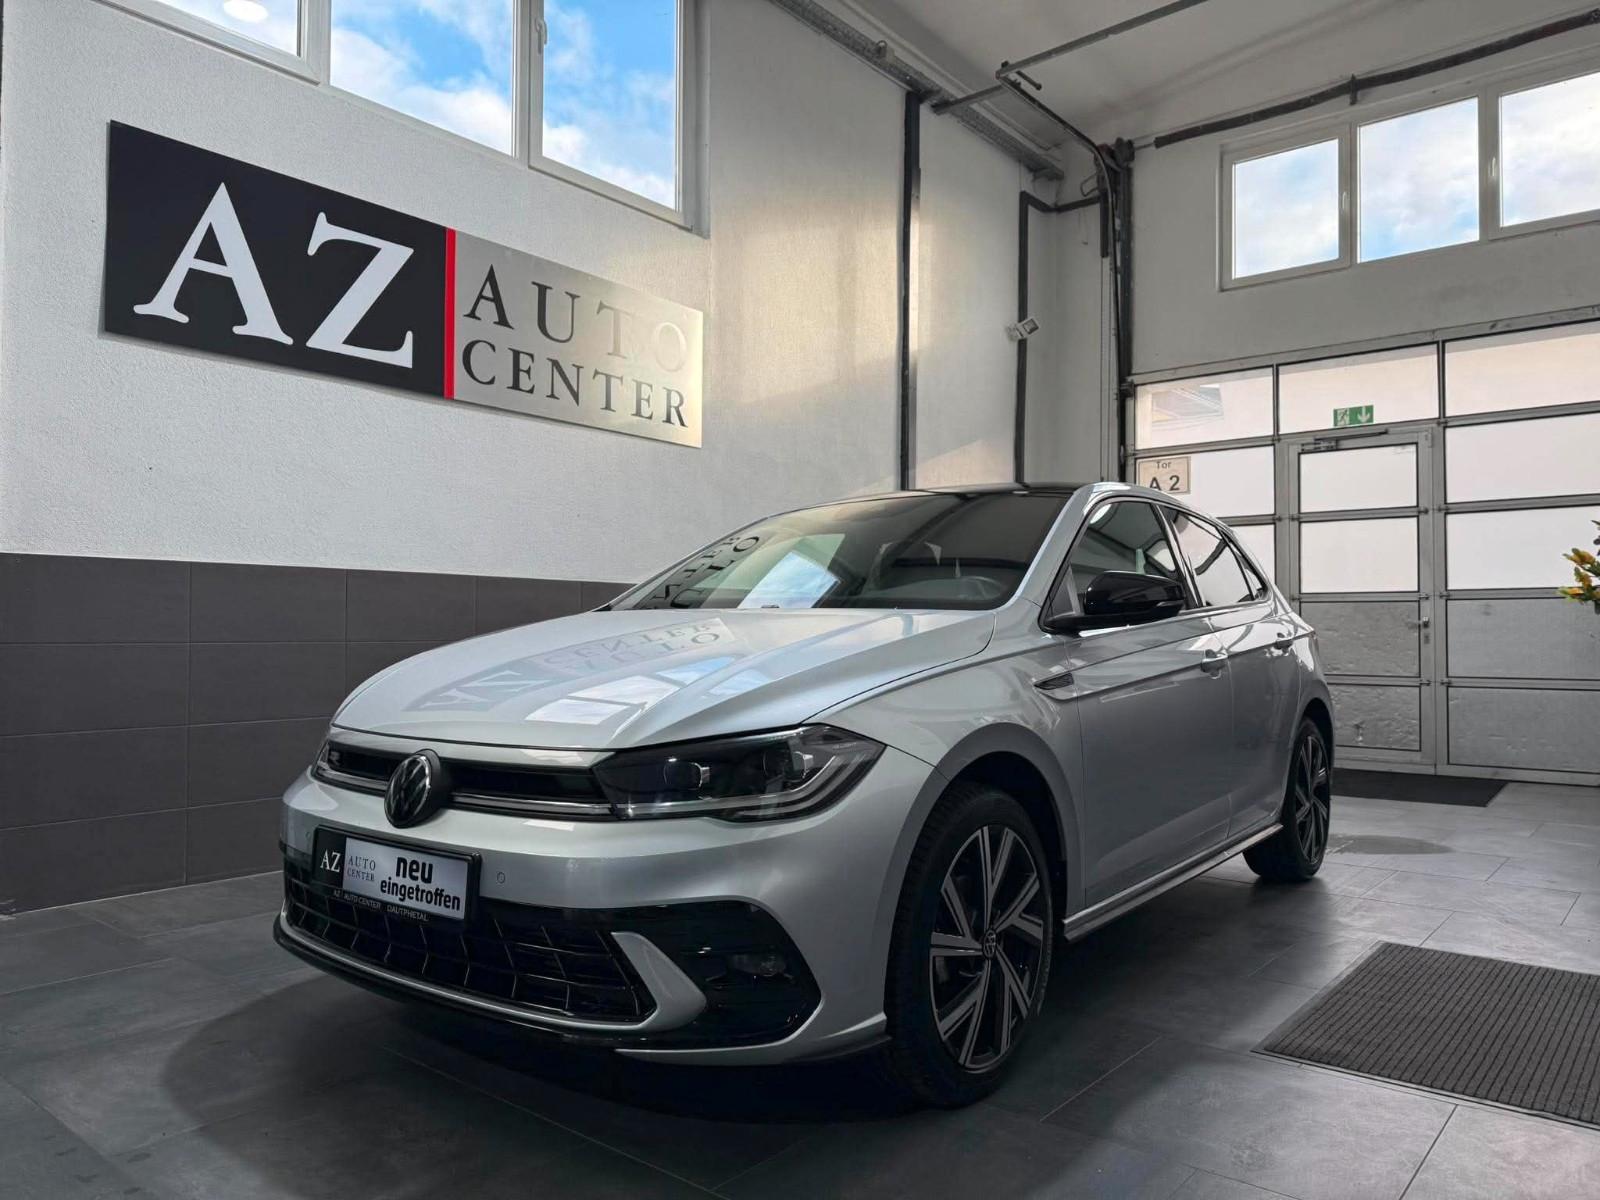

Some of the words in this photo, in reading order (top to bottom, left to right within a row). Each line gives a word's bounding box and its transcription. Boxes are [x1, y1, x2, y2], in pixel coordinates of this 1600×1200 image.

[132, 181, 415, 370] AZ
[463, 263, 688, 373] AUTO
[462, 339, 689, 428] CENTER
[1156, 461, 1172, 469] Tor
[1169, 475, 1180, 491] 2
[320, 850, 341, 873] AZ
[348, 855, 376, 871] AUTO
[396, 856, 434, 884] neu
[347, 867, 375, 882] CENTER
[380, 876, 461, 911] eingetroffen
